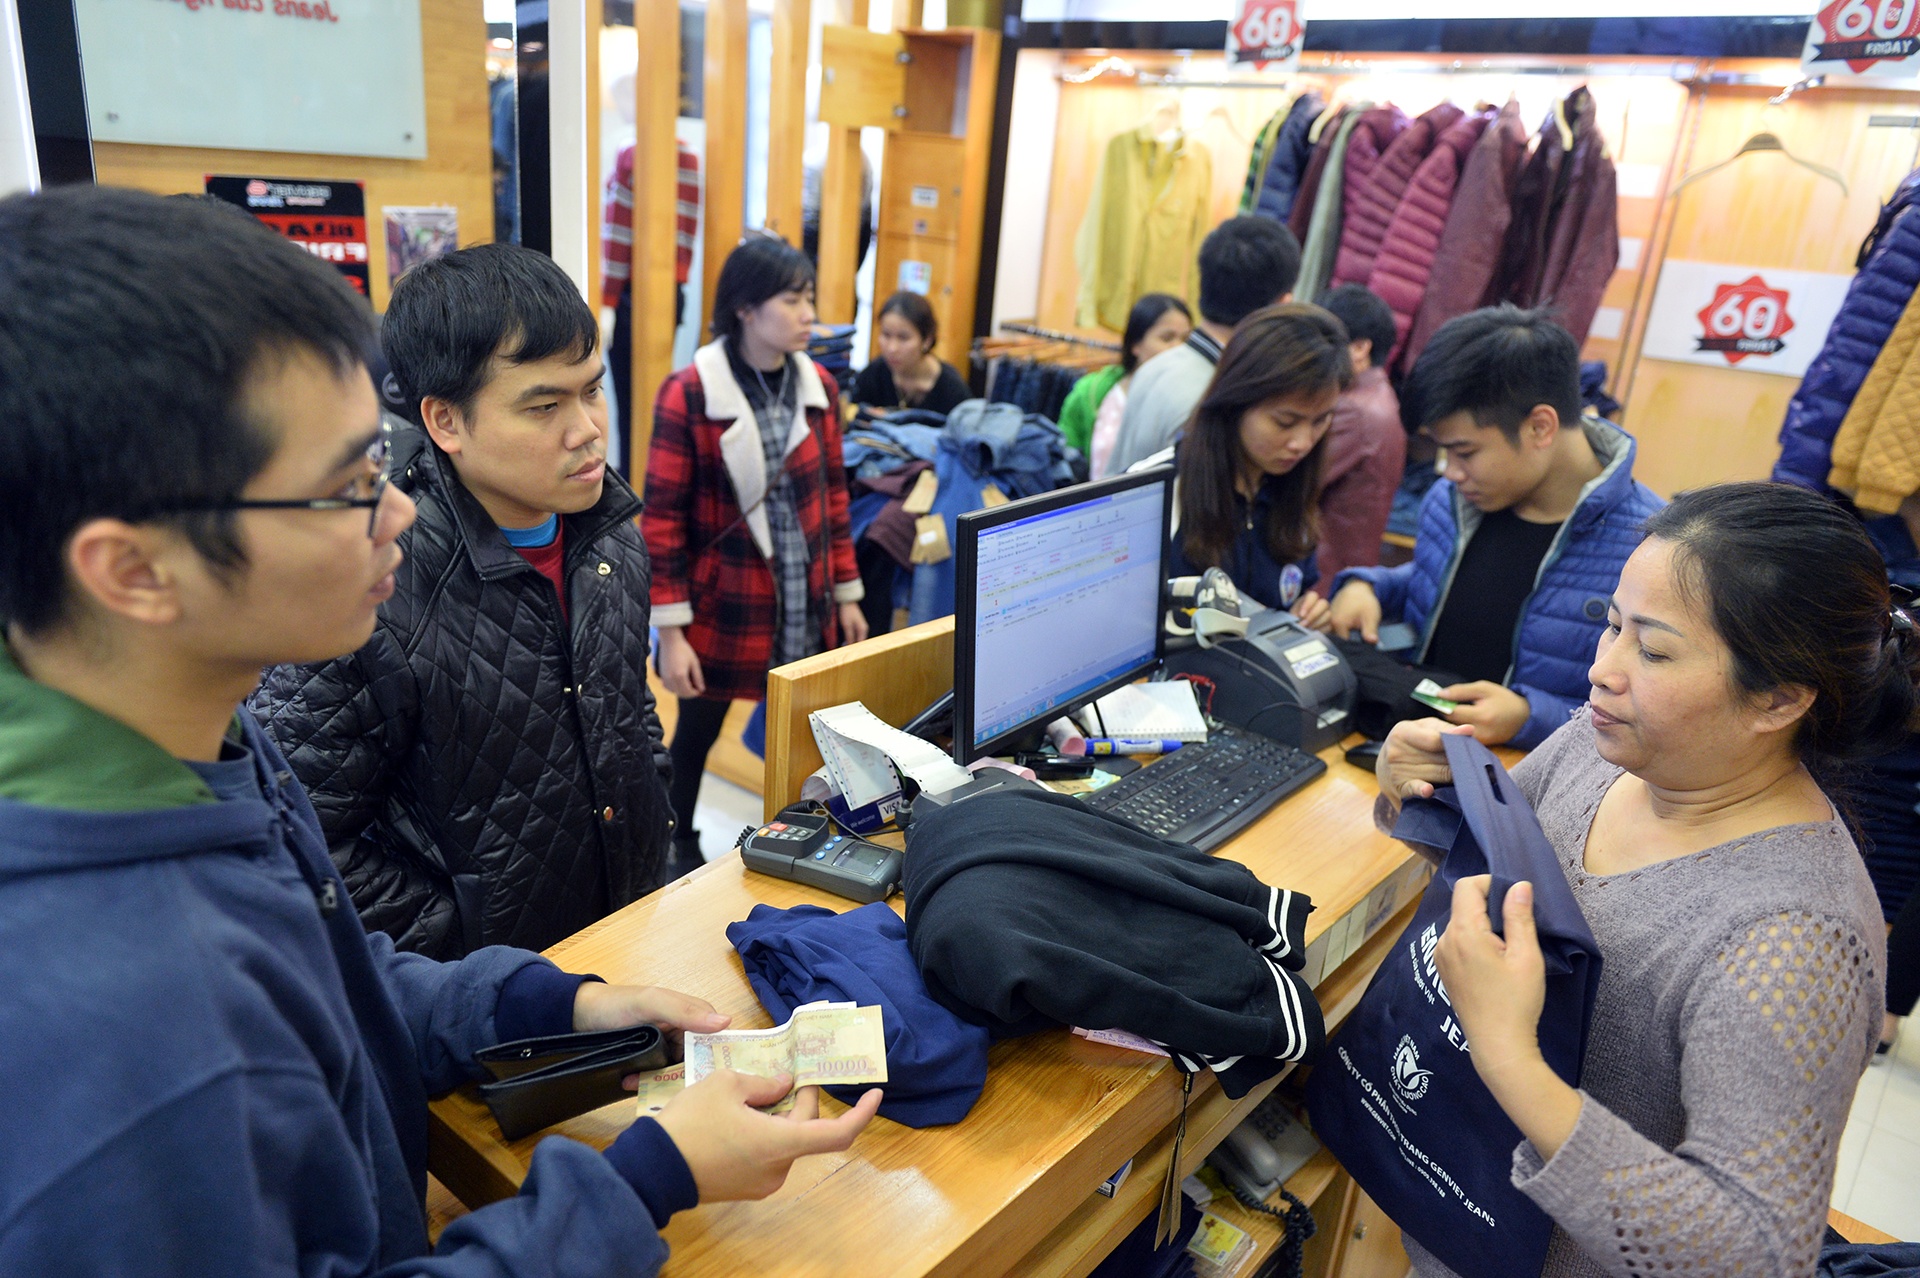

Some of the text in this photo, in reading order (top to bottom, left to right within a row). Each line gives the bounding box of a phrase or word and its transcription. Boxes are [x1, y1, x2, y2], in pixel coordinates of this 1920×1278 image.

[1241, 6, 1292, 47] 60
[1836, 0, 1916, 39] 60
[1864, 40, 1913, 56] FRIDAY
[1711, 293, 1779, 340] 60
[816, 1058, 868, 1074] 10000
[1351, 1066, 1361, 1080] TY
[1400, 1133, 1429, 1165] TRANG
[1430, 1161, 1465, 1200] GENVIET
[1463, 1198, 1496, 1227] JEANS
